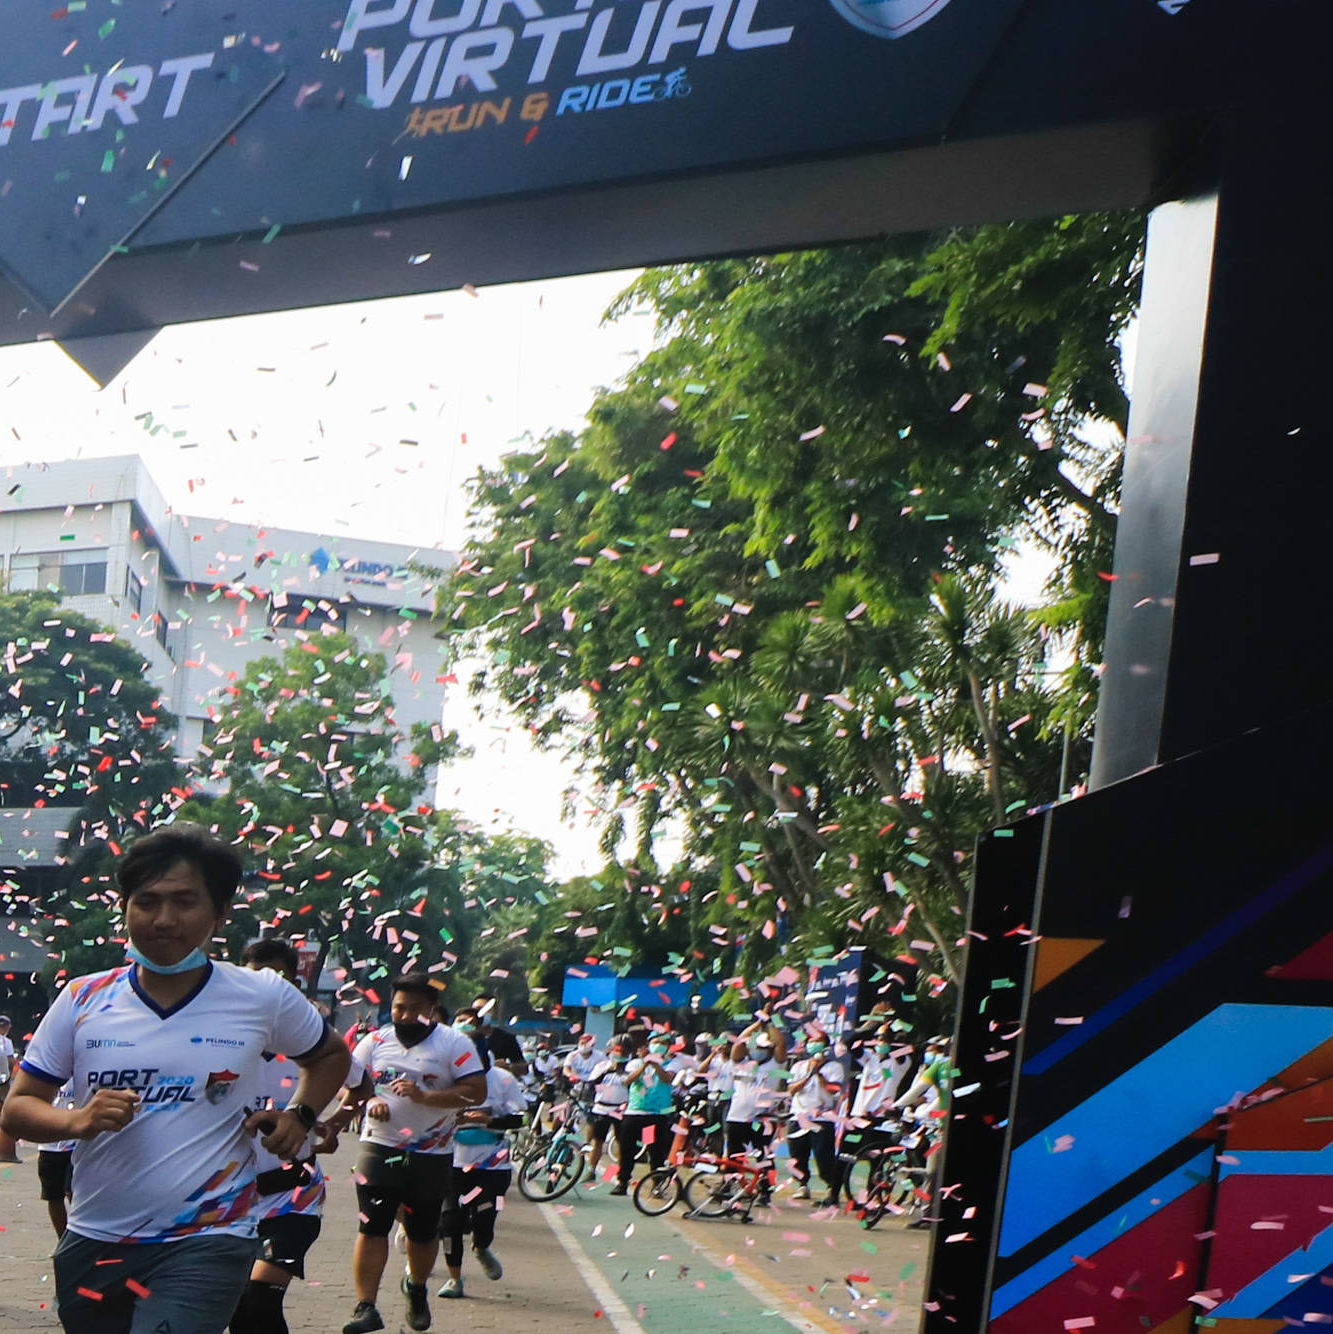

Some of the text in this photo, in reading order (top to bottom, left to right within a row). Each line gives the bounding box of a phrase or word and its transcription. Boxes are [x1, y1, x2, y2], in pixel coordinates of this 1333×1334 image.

[337, 0, 594, 51] PO
[366, 0, 794, 109] VIRTUAL
[417, 98, 510, 138] RUN
[556, 74, 662, 116] RIDE
[88, 1069, 159, 1087] PORT
